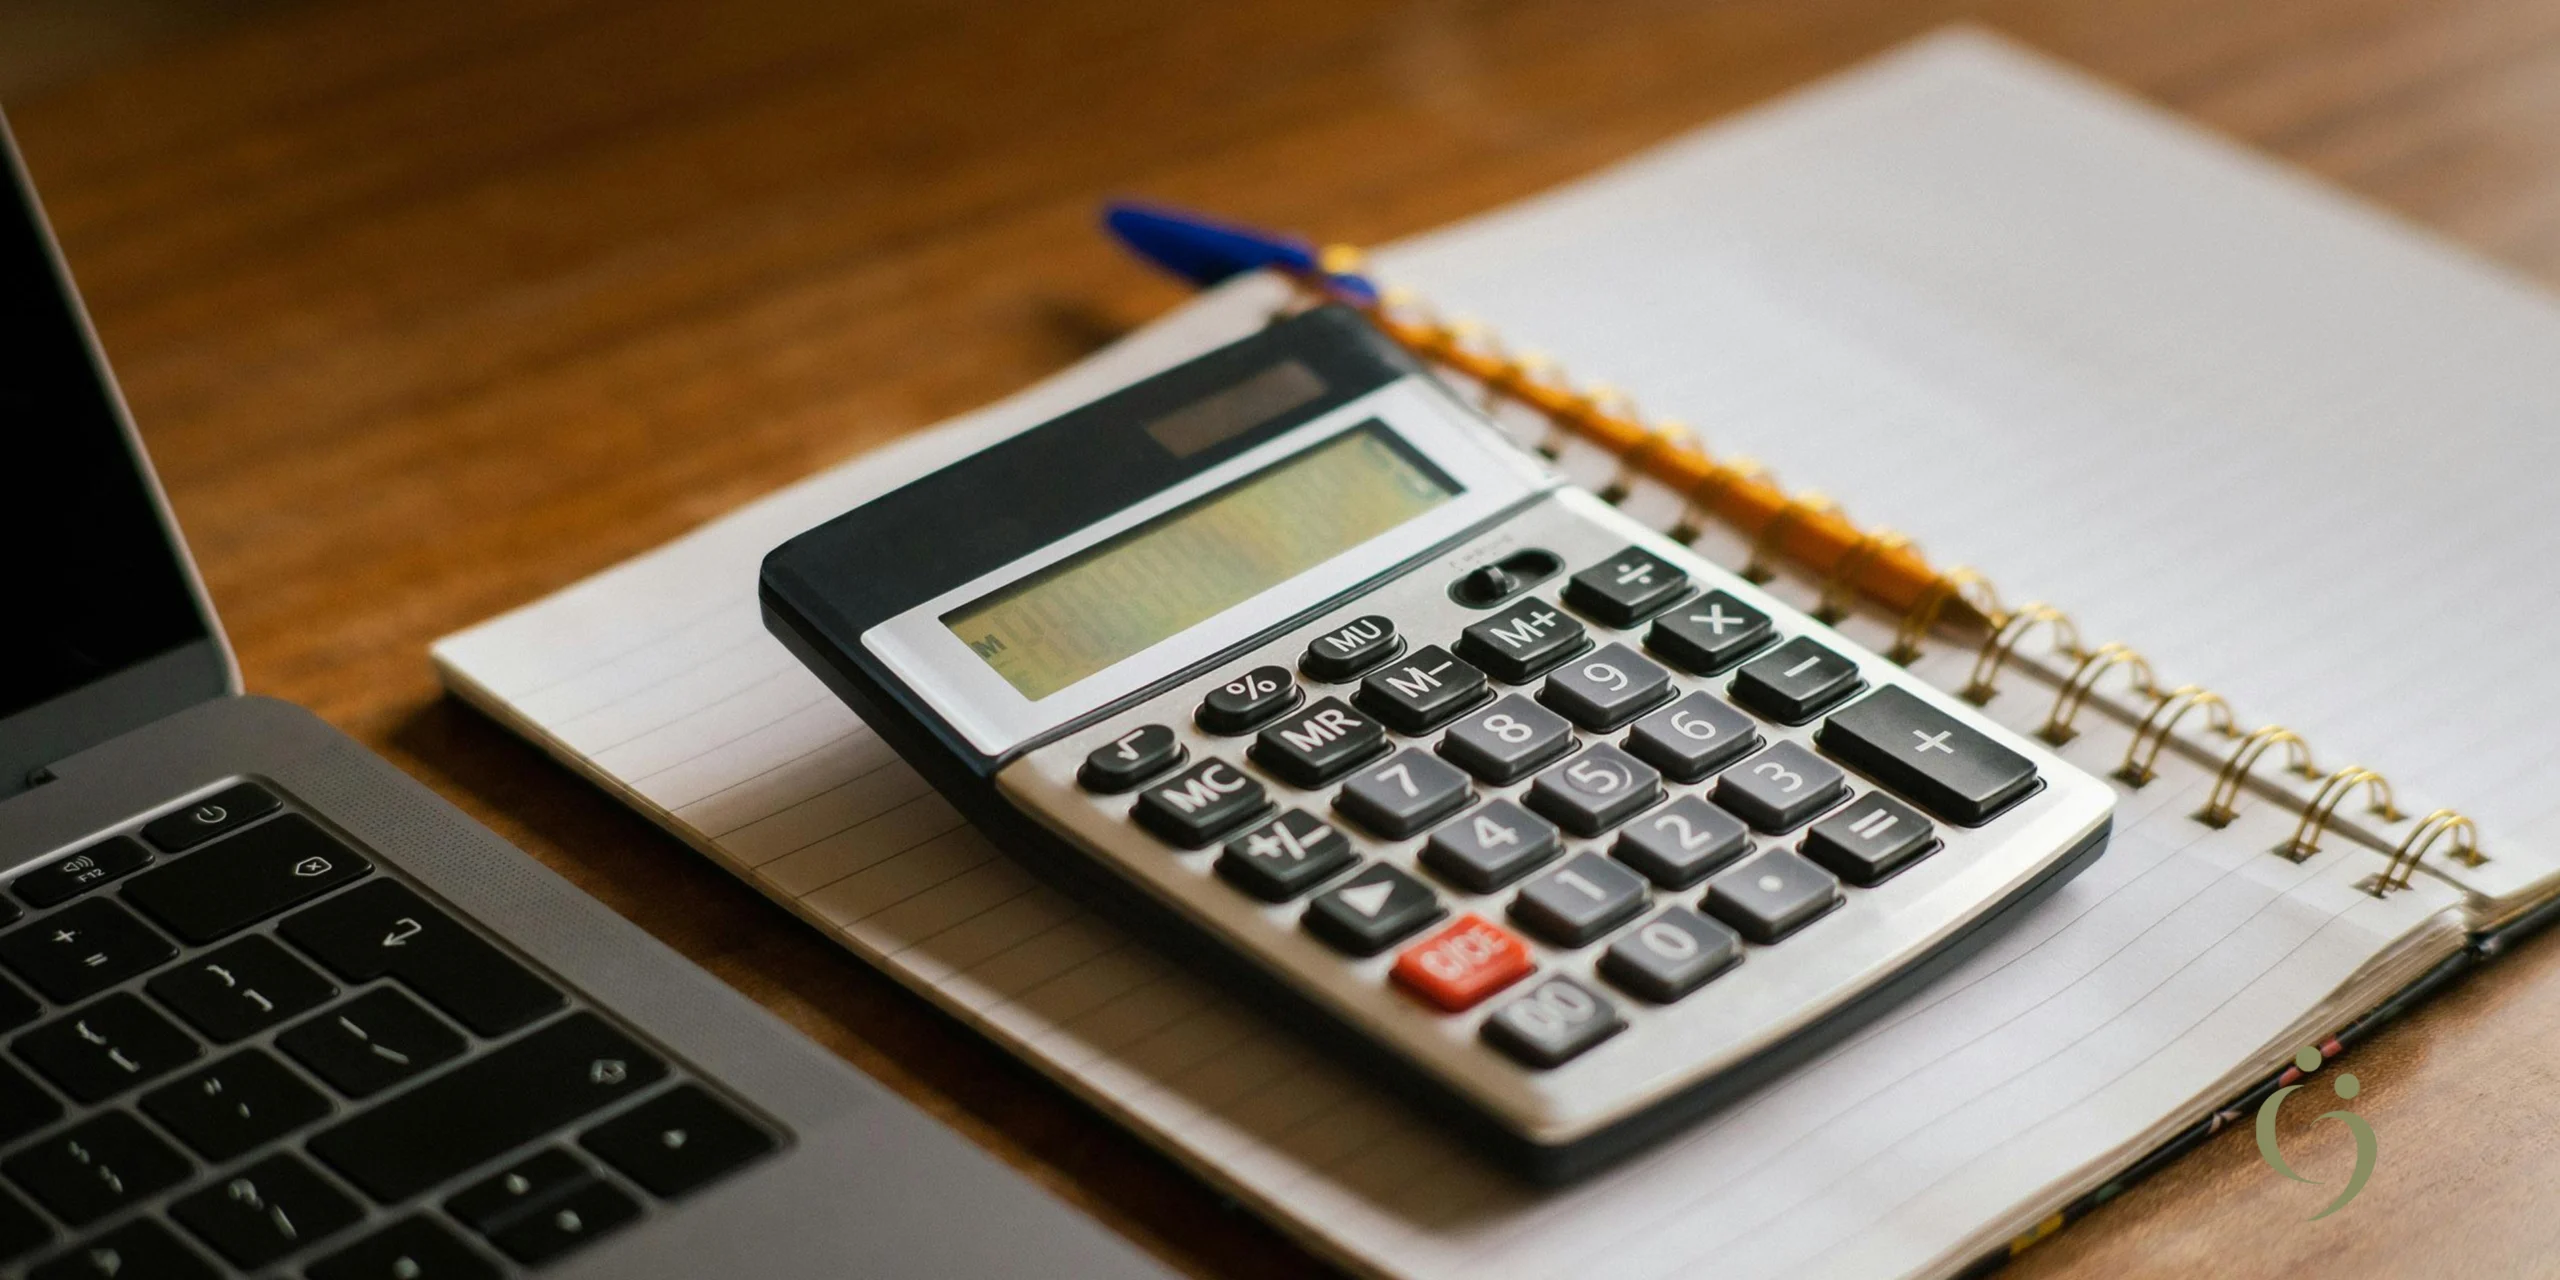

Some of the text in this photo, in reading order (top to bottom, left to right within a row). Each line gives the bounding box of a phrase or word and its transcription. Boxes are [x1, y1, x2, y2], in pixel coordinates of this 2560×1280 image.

[1325, 619, 1382, 652] MU
[1490, 610, 1556, 649] M+
[971, 634, 1007, 658] M
[1226, 675, 1277, 700] %
[1387, 661, 1452, 698] M-
[1583, 663, 1628, 692] 9
[1280, 709, 1362, 752] MR
[1483, 715, 1533, 744] 8
[1670, 711, 1716, 741] 6
[1162, 764, 1246, 813] MC
[1377, 764, 1420, 797] 7
[1570, 762, 1620, 793] 5
[1754, 762, 1804, 793] 3
[1472, 820, 1520, 850] 4
[1654, 814, 1710, 850] 2
[78, 868, 105, 882] F12
[1556, 869, 1605, 899] 1
[1640, 925, 1695, 959] 0
